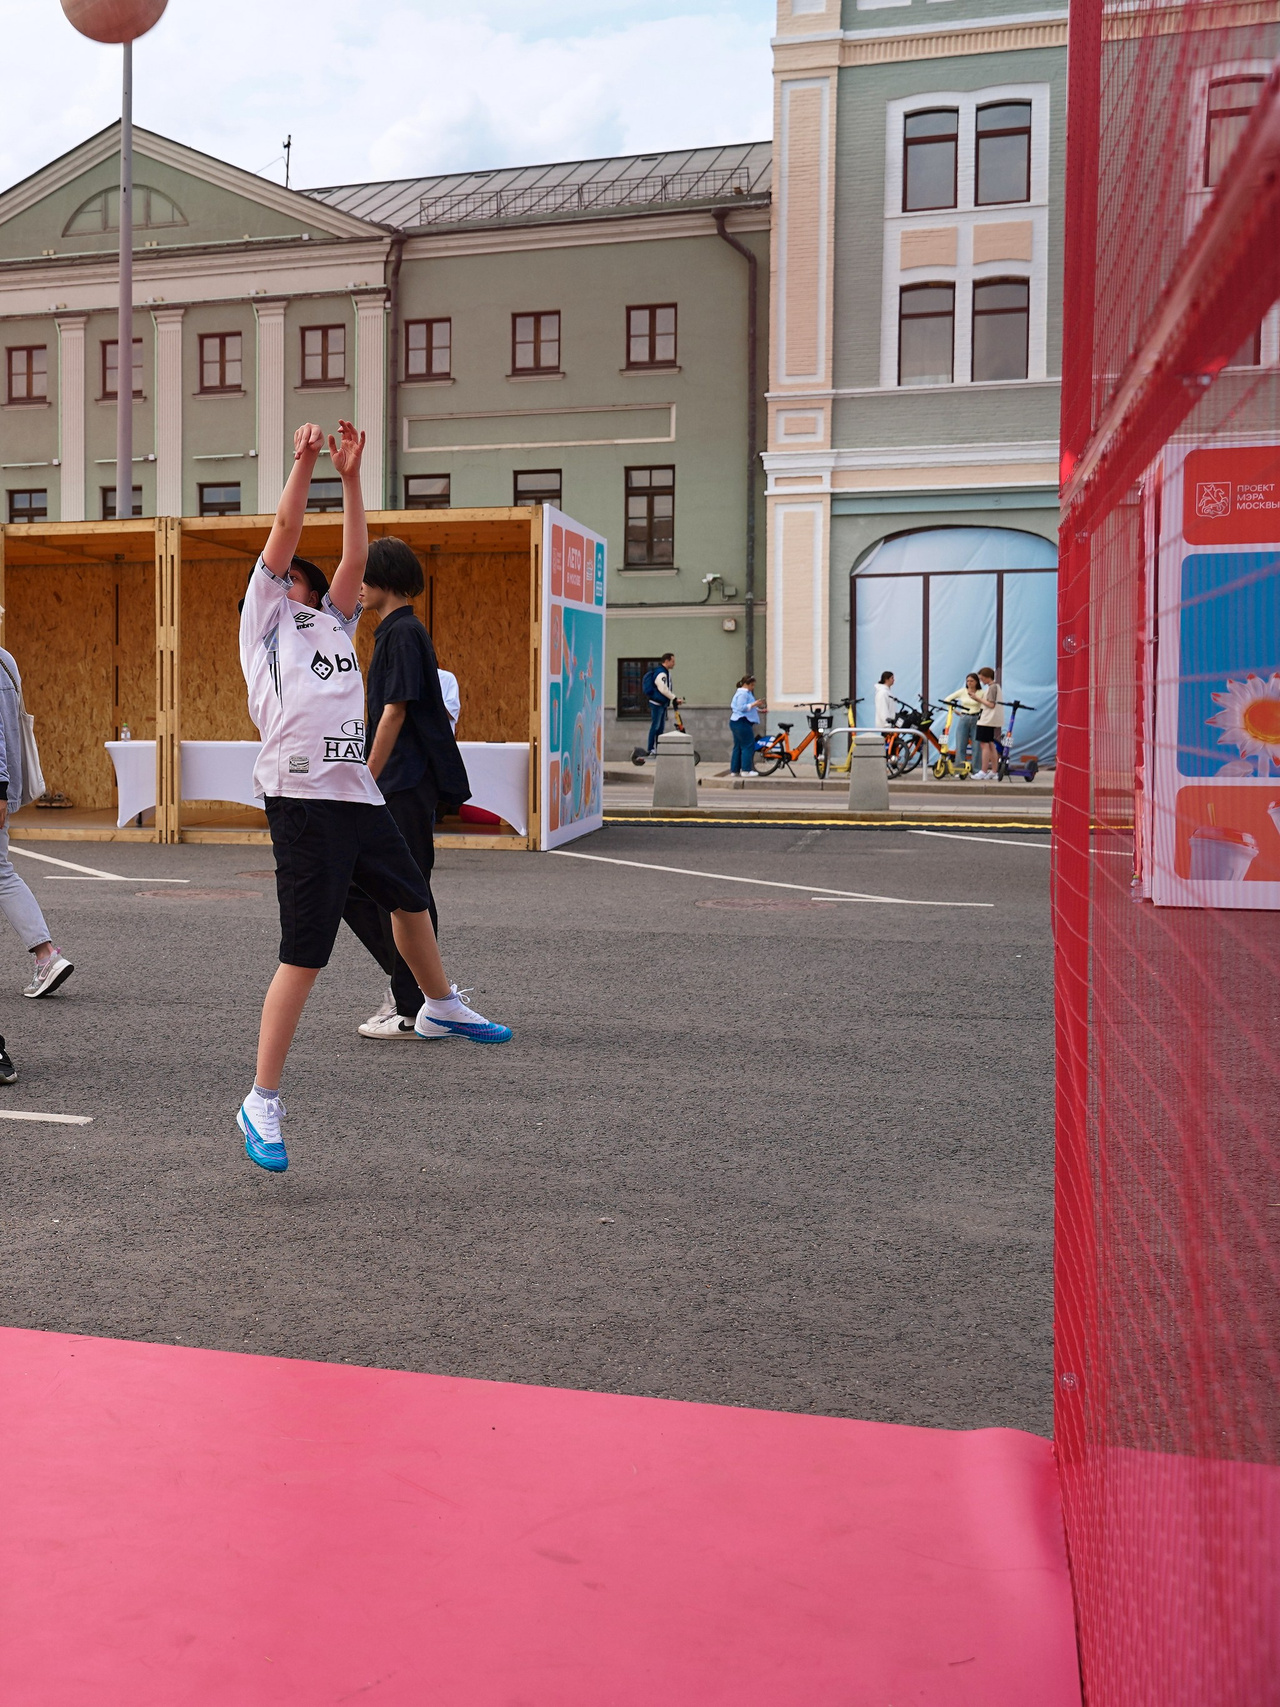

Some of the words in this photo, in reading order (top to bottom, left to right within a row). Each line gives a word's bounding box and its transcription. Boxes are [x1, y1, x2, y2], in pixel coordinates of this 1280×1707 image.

[1237, 484, 1275, 492] ПРОЕКТ
[1236, 493, 1264, 501] МЭРА
[1236, 501, 1280, 510] МОСКВЫ
[296, 622, 315, 630] mbro
[335, 652, 361, 673] bl
[324, 741, 365, 759] HAV
